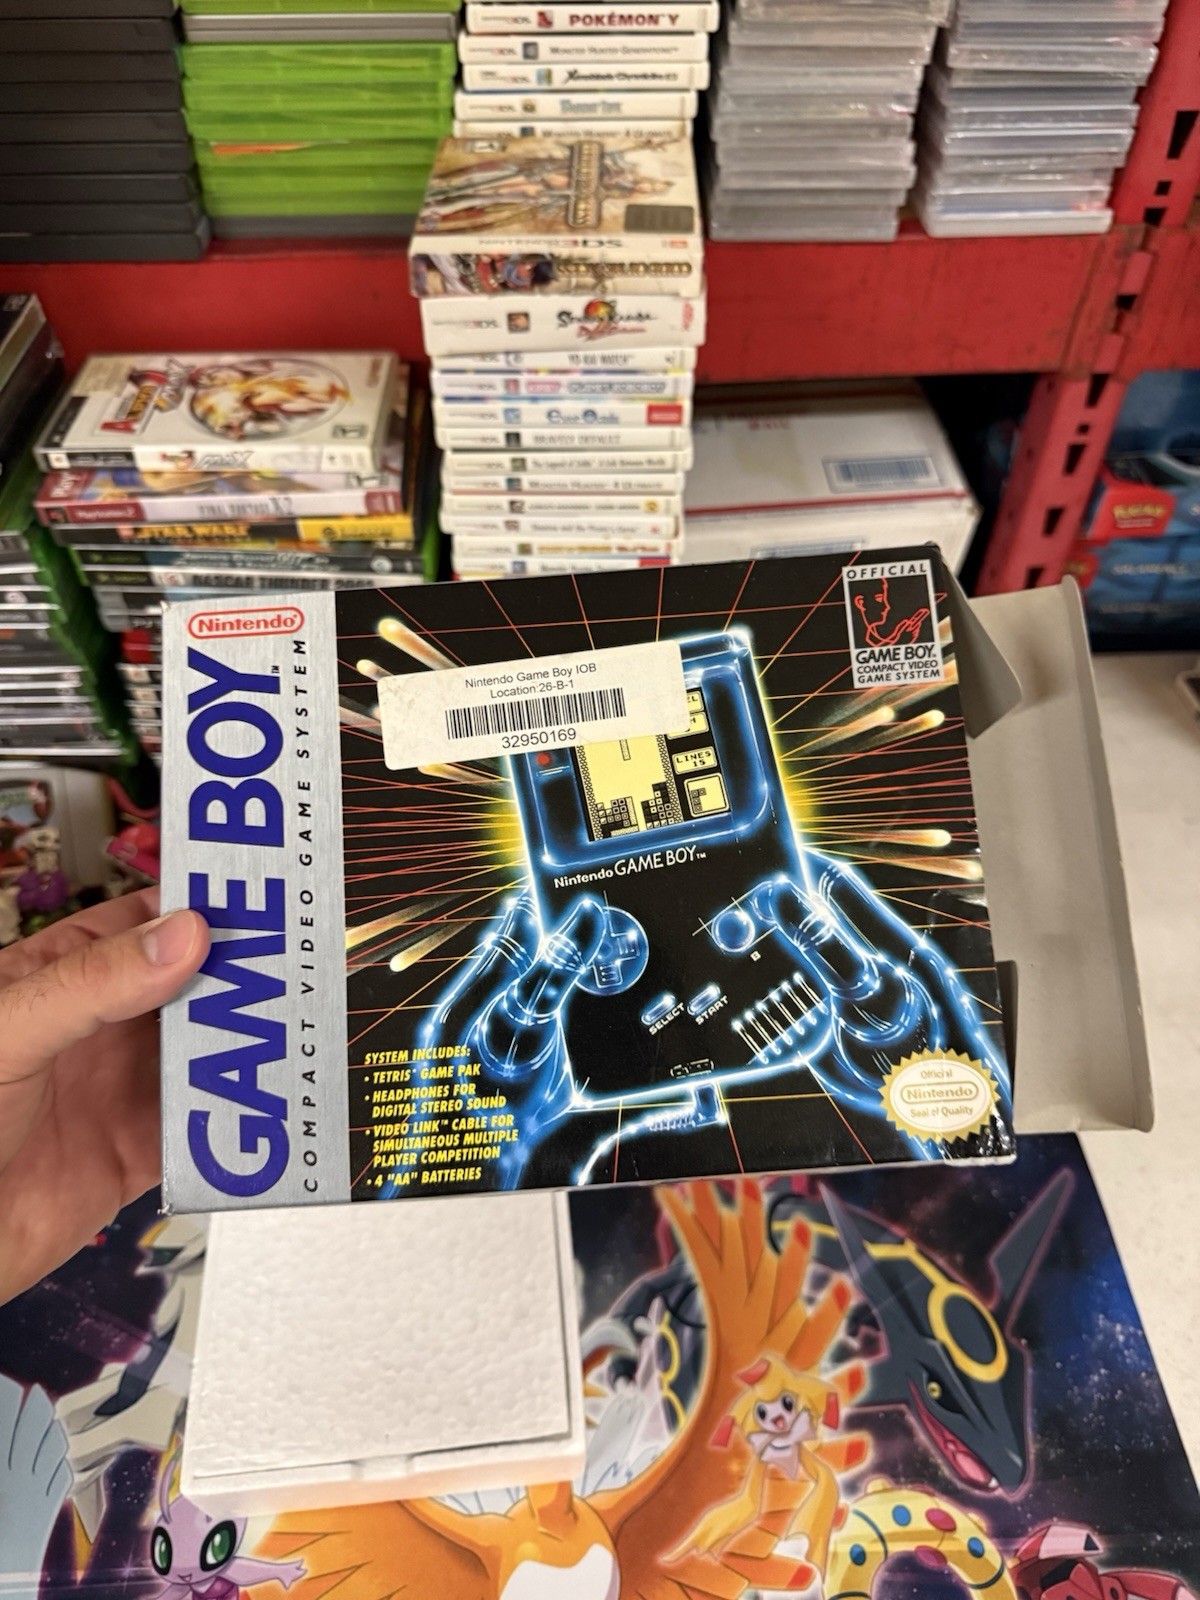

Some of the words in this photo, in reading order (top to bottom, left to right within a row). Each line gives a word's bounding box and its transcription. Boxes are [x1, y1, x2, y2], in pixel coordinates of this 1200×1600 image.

[569, 11, 660, 26] POKÉMON
[667, 14, 680, 26] Y
[846, 562, 927, 580] OFFICIAL
[198, 613, 296, 634] Nintendo
[855, 647, 903, 665] GAME
[856, 661, 906, 675] COMPACT
[907, 659, 939, 670] VIDEO
[857, 671, 893, 684] GAME
[895, 668, 941, 681] SYSTEM
[465, 673, 514, 690] Nintendo
[516, 669, 551, 684] Game
[552, 666, 574, 680] Boy
[292, 639, 311, 760] SYSTEM
[490, 679, 575, 699] Location:26-B-1
[501, 727, 577, 750] 32950169
[676, 750, 712, 764] LINES
[692, 759, 706, 768] 15
[297, 780, 313, 867] GAME
[554, 867, 614, 889] Nintendo
[614, 851, 664, 877] GAME
[299, 888, 315, 995] VIDEO
[649, 1002, 686, 1036] SELECT
[695, 994, 729, 1025] START
[187, 872, 290, 1198] GAME
[364, 1050, 409, 1066] SYSTEM
[412, 1045, 471, 1061] INCLUDES:
[420, 1065, 454, 1080] GAME
[457, 1063, 482, 1077] PAK
[920, 1069, 954, 1080] Official
[372, 1085, 450, 1103] HEADPHONES
[453, 1083, 477, 1097] FOR
[906, 1086, 974, 1101] Nintendo
[300, 1019, 319, 1193] COMPACT
[372, 1104, 417, 1119] DIGITAL
[420, 1100, 463, 1114] STEREO
[467, 1095, 507, 1110] SOUND
[910, 1107, 930, 1119] Seal
[941, 1105, 974, 1118] Quality
[373, 1122, 410, 1138] VIDEO
[452, 1117, 488, 1131] CABLE
[490, 1114, 515, 1128] FOR
[372, 1133, 460, 1153] SIMULTANEOUS
[463, 1129, 519, 1145] MULTIPLE
[373, 1153, 417, 1169] PLAYER
[420, 1145, 501, 1164] COMPETITION
[374, 1173, 383, 1188] 4
[387, 1170, 418, 1186] "AA"
[421, 1167, 482, 1184] BATTERIES
